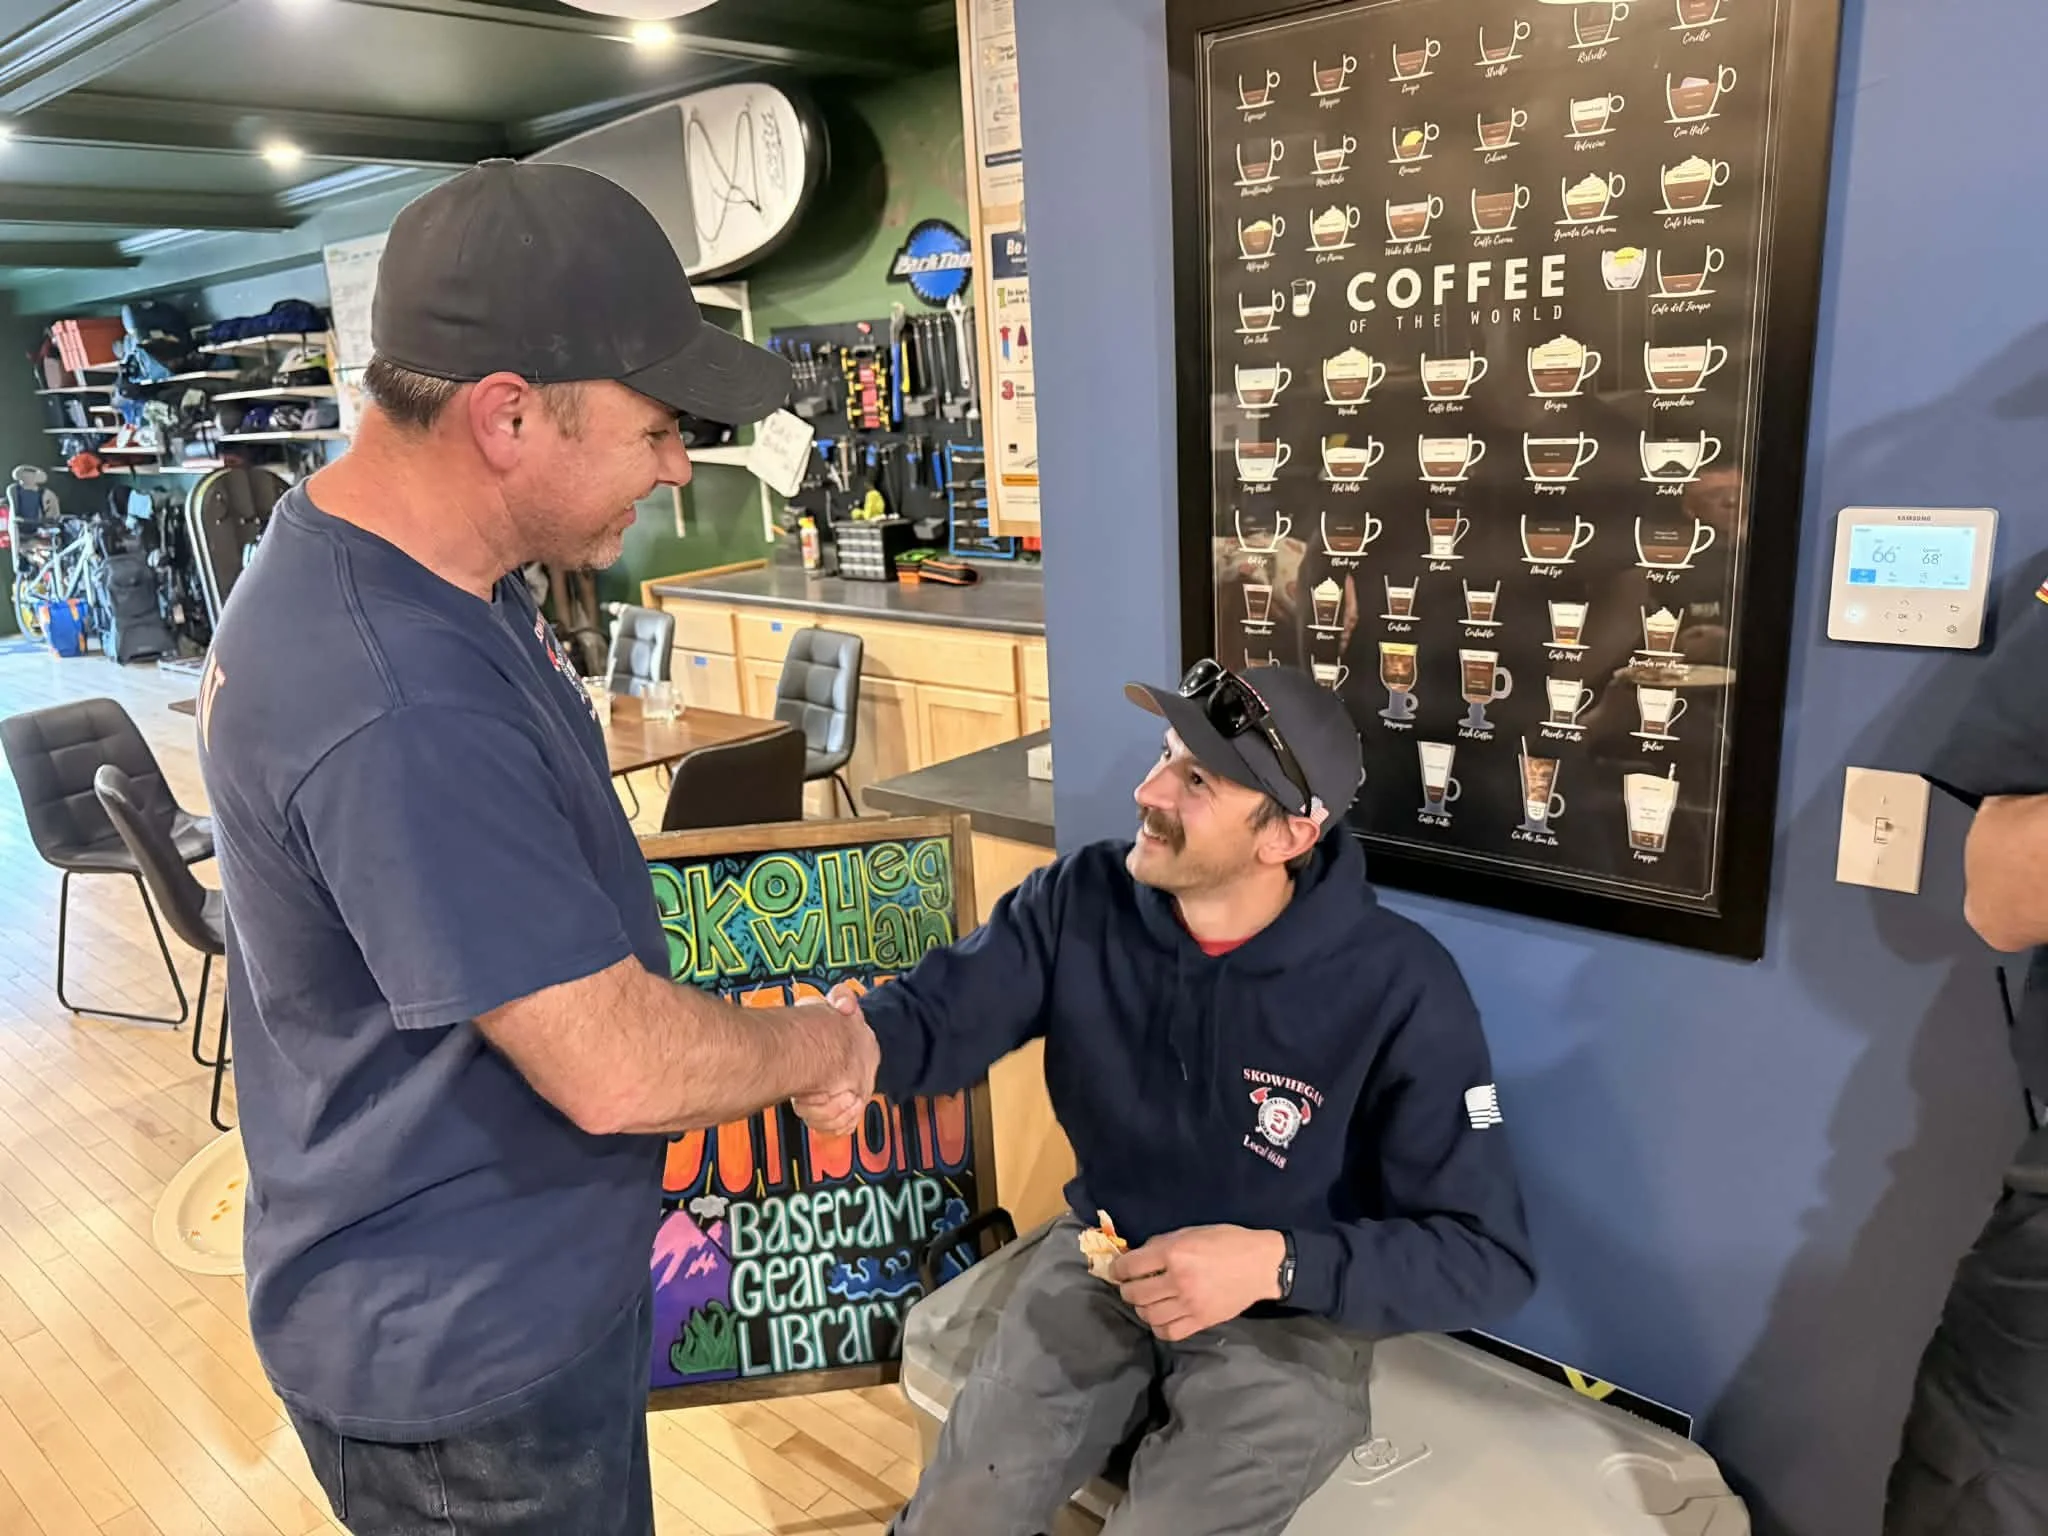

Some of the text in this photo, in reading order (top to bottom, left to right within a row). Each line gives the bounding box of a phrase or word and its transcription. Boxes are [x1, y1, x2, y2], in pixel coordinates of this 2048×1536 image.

[1347, 254, 1566, 312] COFFEE
[1350, 305, 1563, 333] OF THE WORLD
[731, 1251, 837, 1318] Gear
